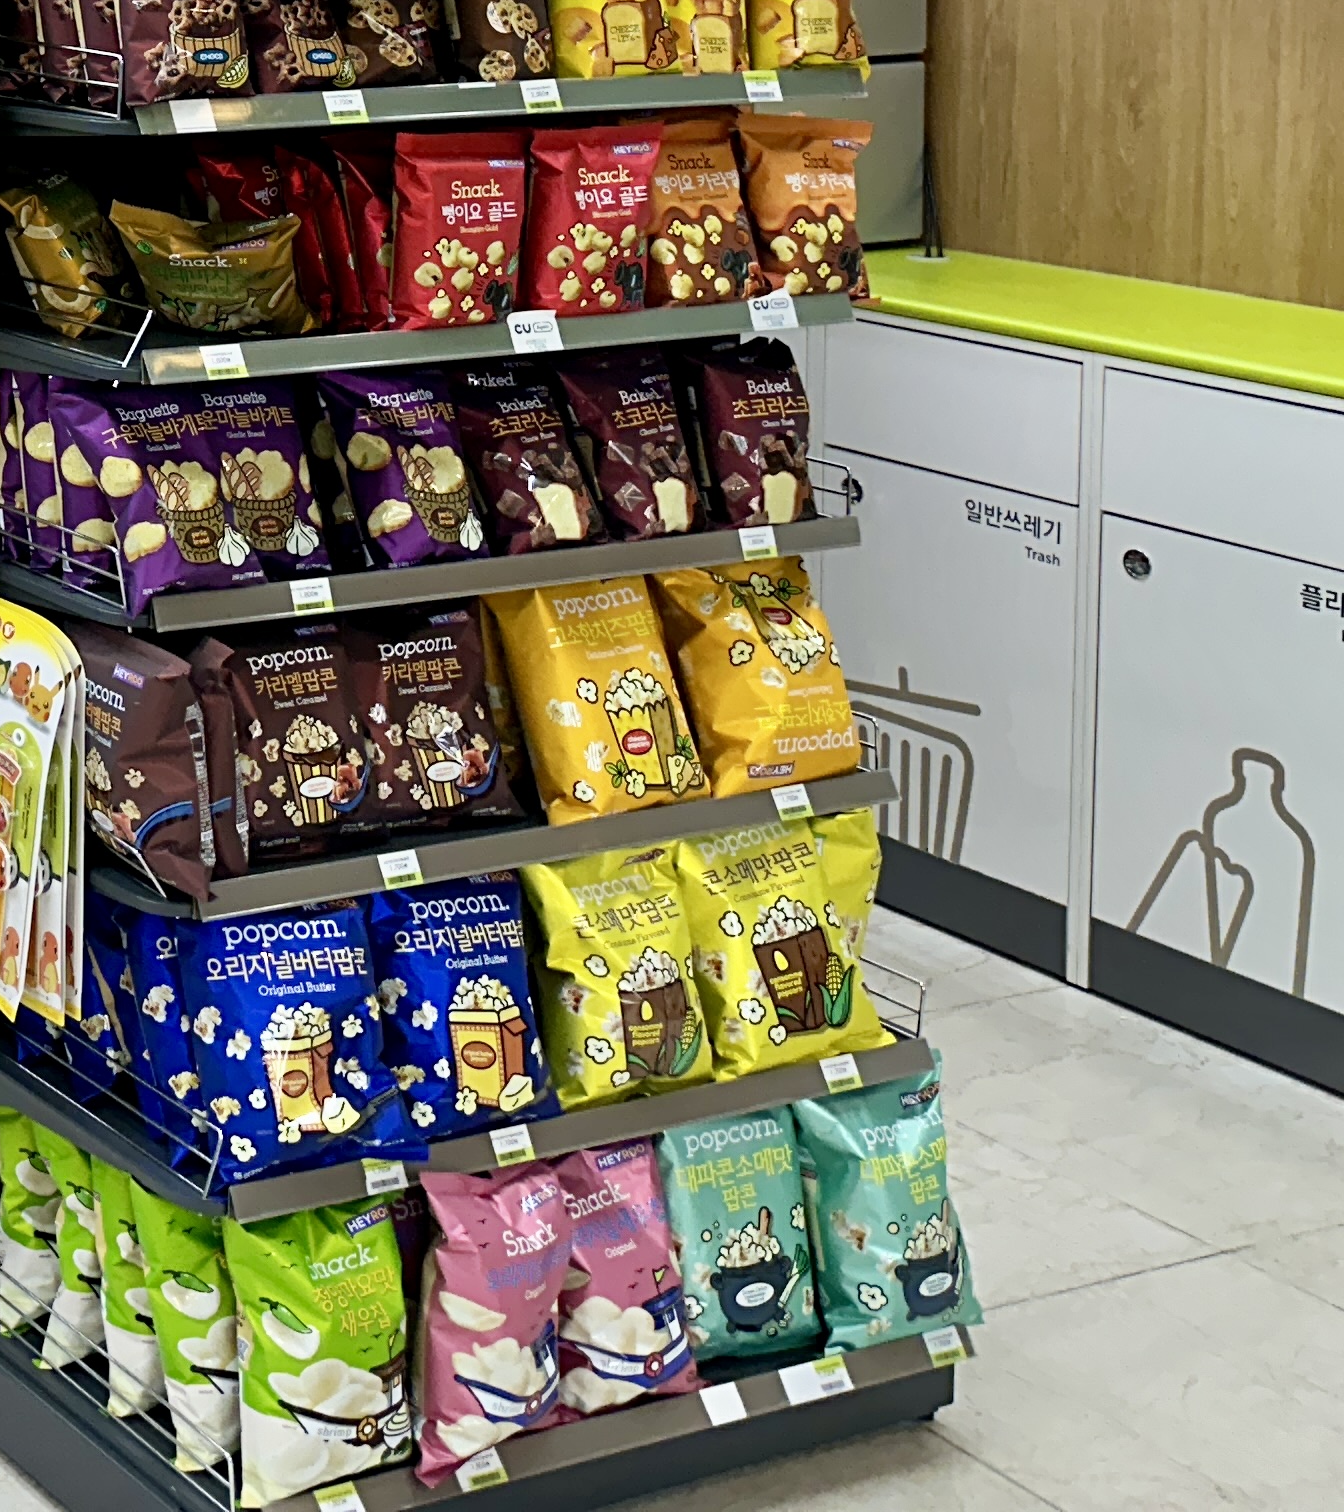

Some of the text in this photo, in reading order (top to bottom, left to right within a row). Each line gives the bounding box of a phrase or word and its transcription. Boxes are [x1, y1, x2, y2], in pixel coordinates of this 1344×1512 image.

[575, 185, 648, 209] 뻥이요 골드
[442, 201, 517, 224] 뻥이요 골드
[753, 300, 769, 310] CU
[515, 323, 532, 334] CU
[202, 393, 267, 407] Baguette
[368, 389, 433, 408] Baguette
[116, 402, 179, 422] Baguette
[964, 498, 1062, 545] 일반쓰레기
[1024, 546, 1061, 567] Trash
[553, 586, 643, 620] popcorn.
[246, 644, 334, 675] popcorn.
[378, 635, 457, 661] popcorn.
[255, 668, 338, 699] 카라멜팝콘
[382, 658, 463, 685] 카라멜팝콘
[701, 842, 817, 896] 콘소메맛팝콘
[409, 893, 510, 925] popcorn.
[572, 895, 681, 939] 콘소메맛팝콘
[222, 917, 347, 952] popcorn.
[205, 946, 368, 984] 오리지널버터팝콘
[445, 953, 508, 970] Original Butter
[258, 980, 336, 997] Original Butter
[684, 1119, 784, 1157] popcorn.
[598, 1146, 645, 1169] HEYROO
[676, 1145, 794, 1191] 대파콘소메맛
[722, 1185, 758, 1211] 팝콘
[338, 1312, 392, 1338] 새우칩
[317, 1425, 352, 1439] shrimp
